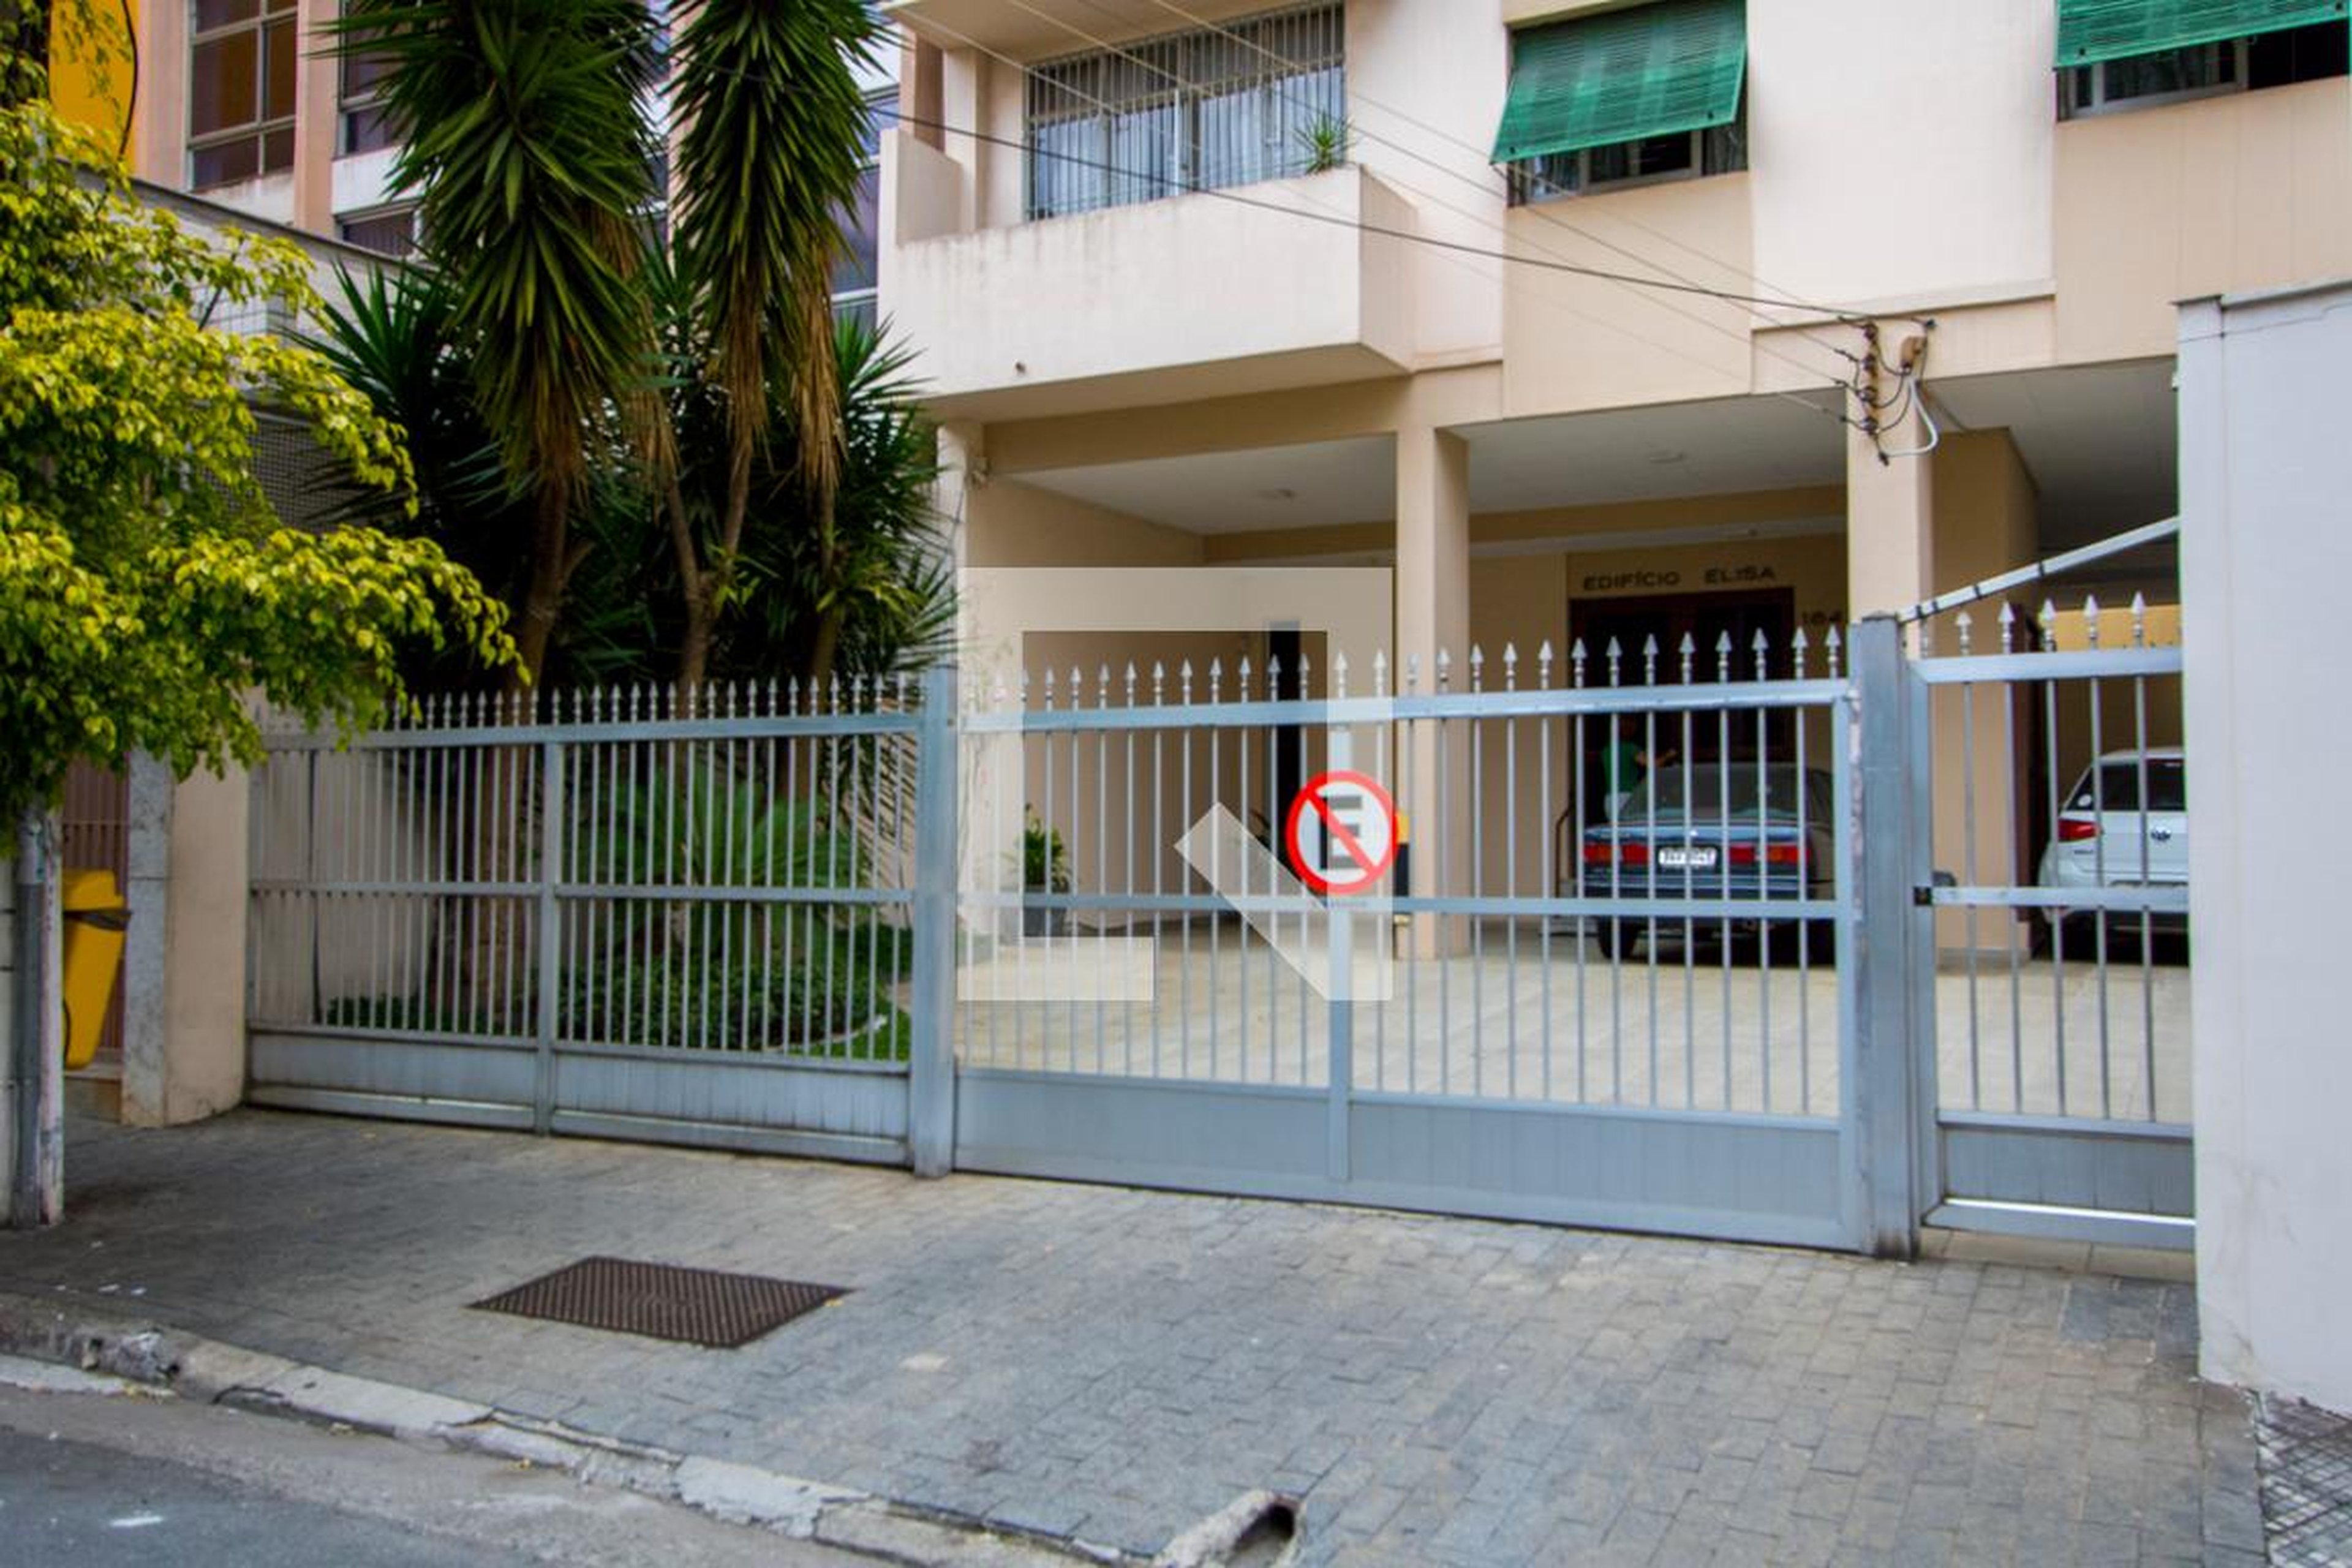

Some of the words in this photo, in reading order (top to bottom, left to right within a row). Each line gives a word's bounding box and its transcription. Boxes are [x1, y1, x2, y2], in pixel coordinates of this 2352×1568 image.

[1583, 570, 1681, 591] EDIFÍCIO
[1705, 565, 1776, 585] ELISA
[1319, 795, 1363, 870] E
